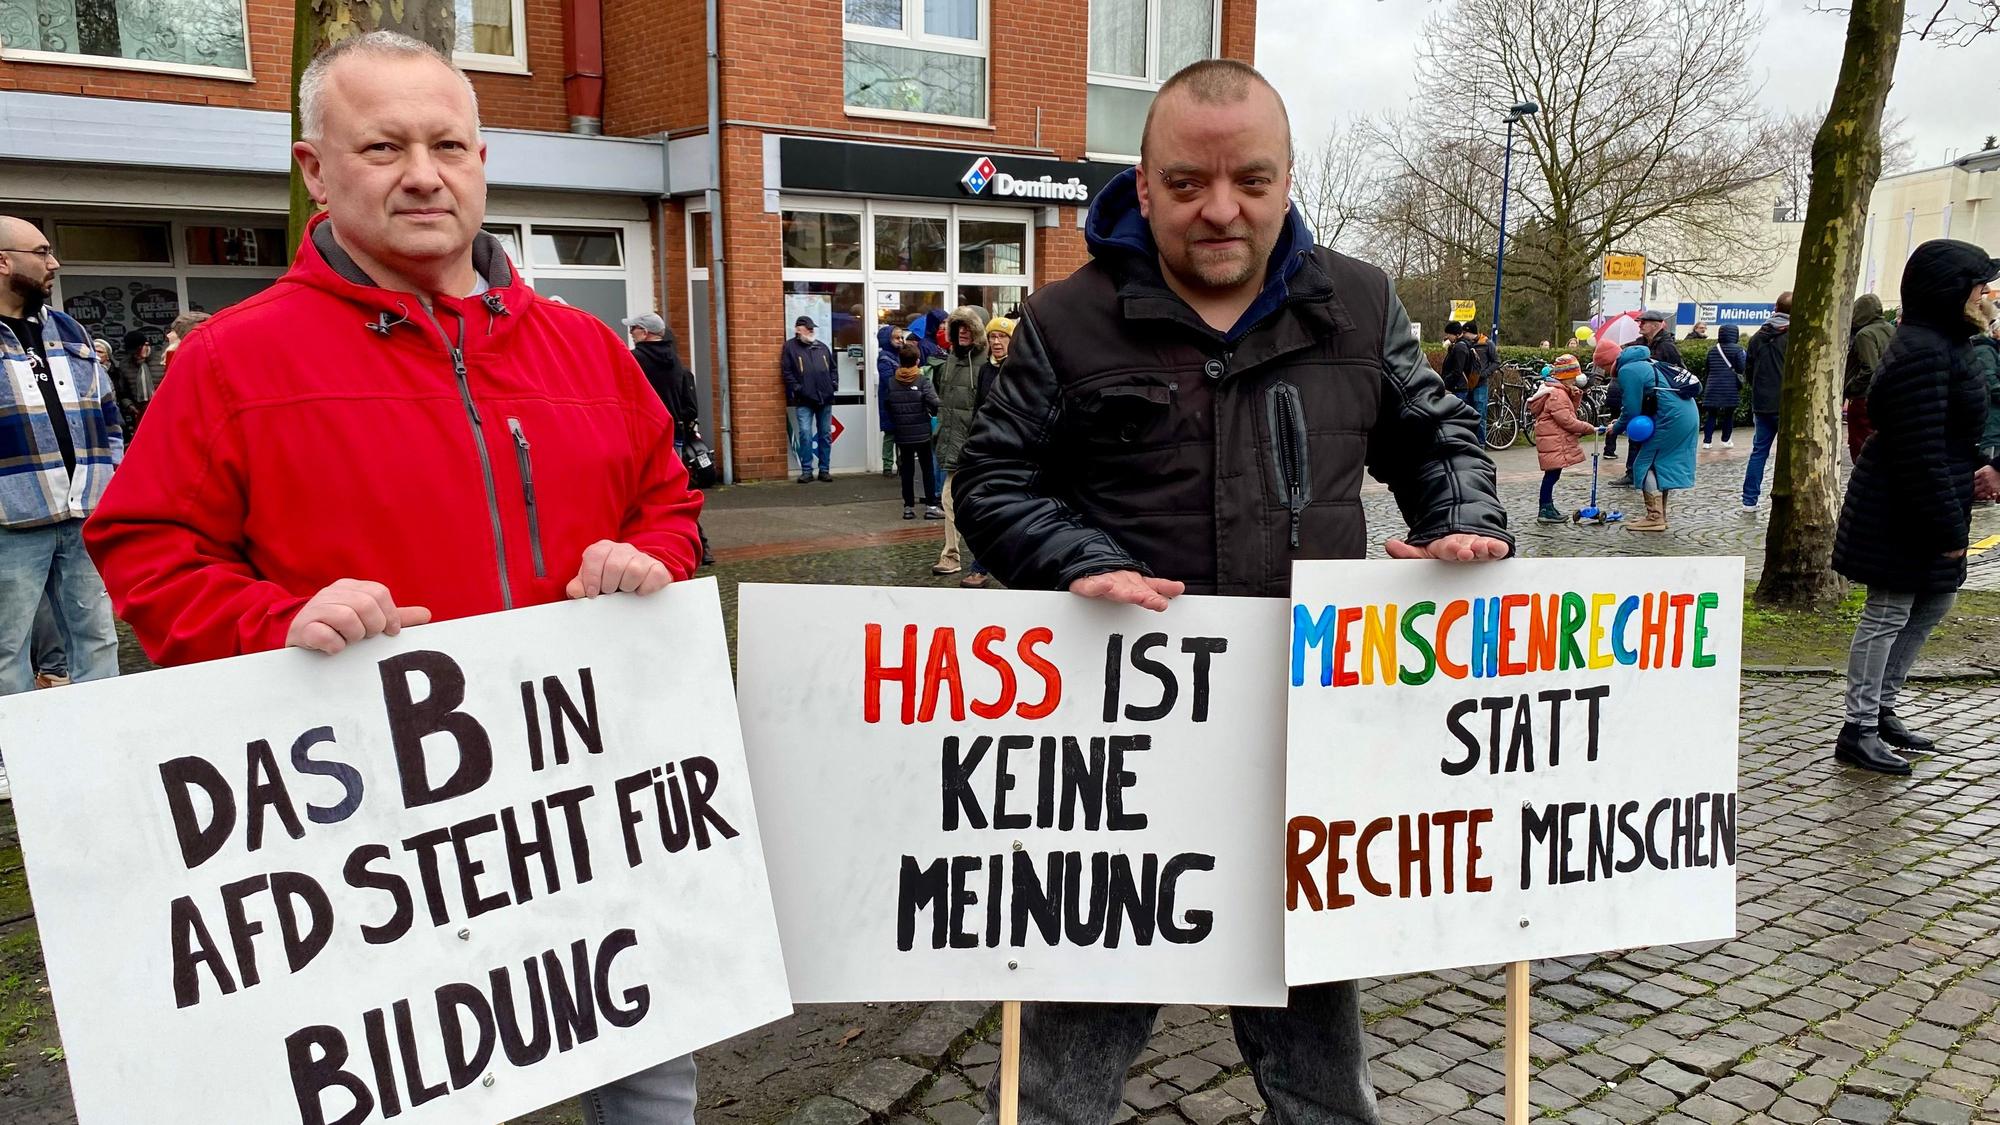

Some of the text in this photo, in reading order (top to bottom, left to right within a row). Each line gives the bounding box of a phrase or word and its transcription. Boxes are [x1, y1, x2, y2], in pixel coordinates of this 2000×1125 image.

[993, 173, 1088, 200] Domino's
[864, 623, 1228, 725] HASS IST
[1292, 591, 1718, 687] MENSCHENRECHTE
[159, 650, 603, 869] DAS B IN
[1441, 685, 1610, 776] STATT
[942, 735, 1151, 831] KEINE
[171, 755, 740, 1009] AFD STEHT FÜR
[897, 850, 1215, 951] MEINUNG
[1286, 792, 1736, 911] RECHTE MENSCHEN
[285, 929, 650, 1125] BILDUNG
